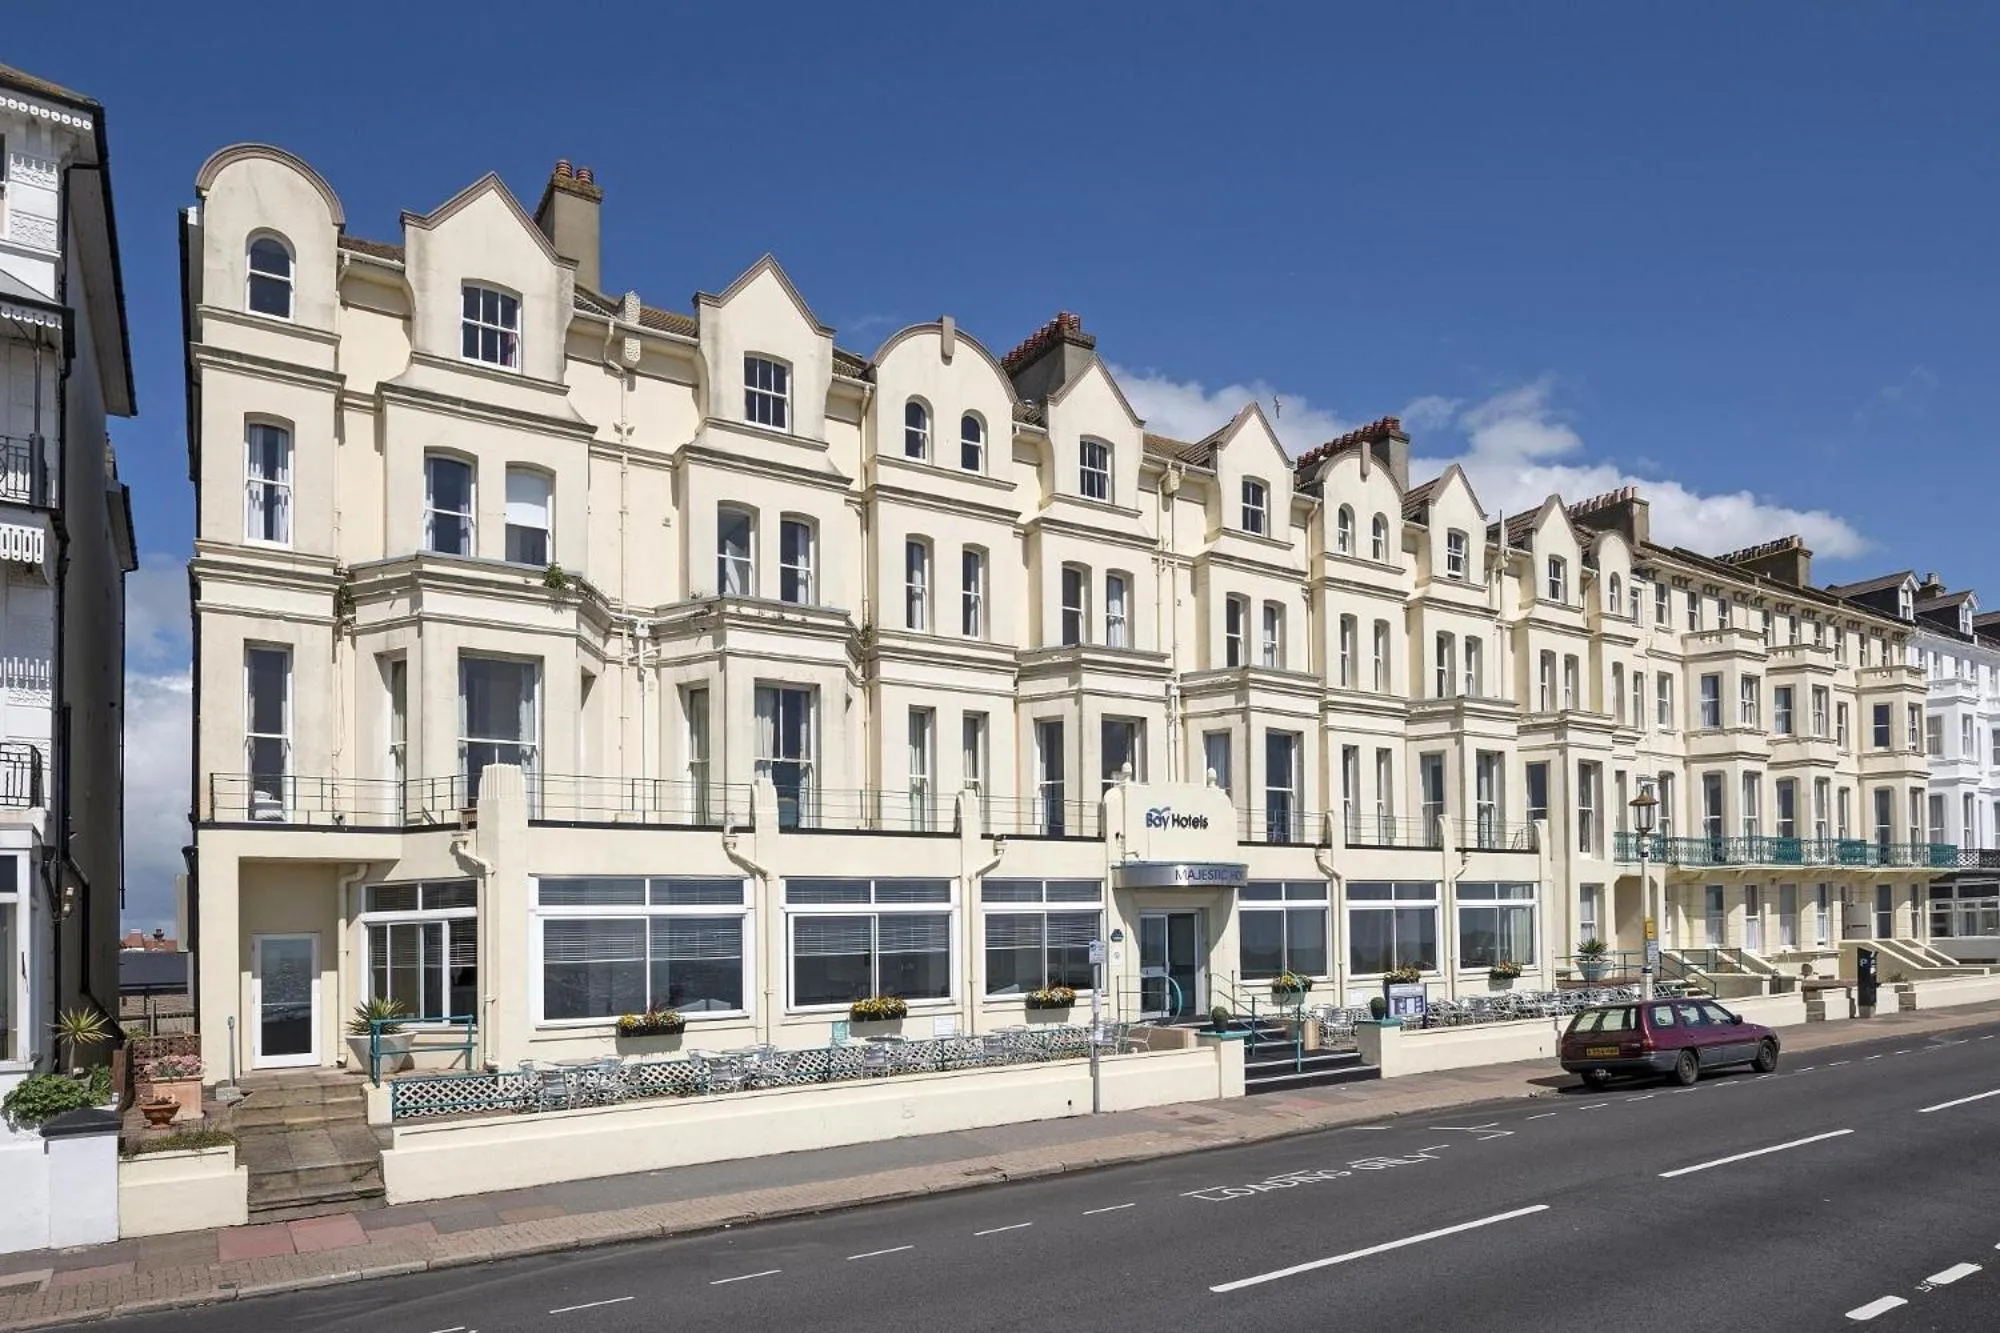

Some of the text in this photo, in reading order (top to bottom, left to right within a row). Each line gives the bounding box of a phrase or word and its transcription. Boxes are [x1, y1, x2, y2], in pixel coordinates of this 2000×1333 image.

[1146, 813, 1209, 831] Bay Hotels
[1175, 868, 1227, 881] MAJESTIC
[1192, 1153, 1440, 1201] LOADING ONLY
